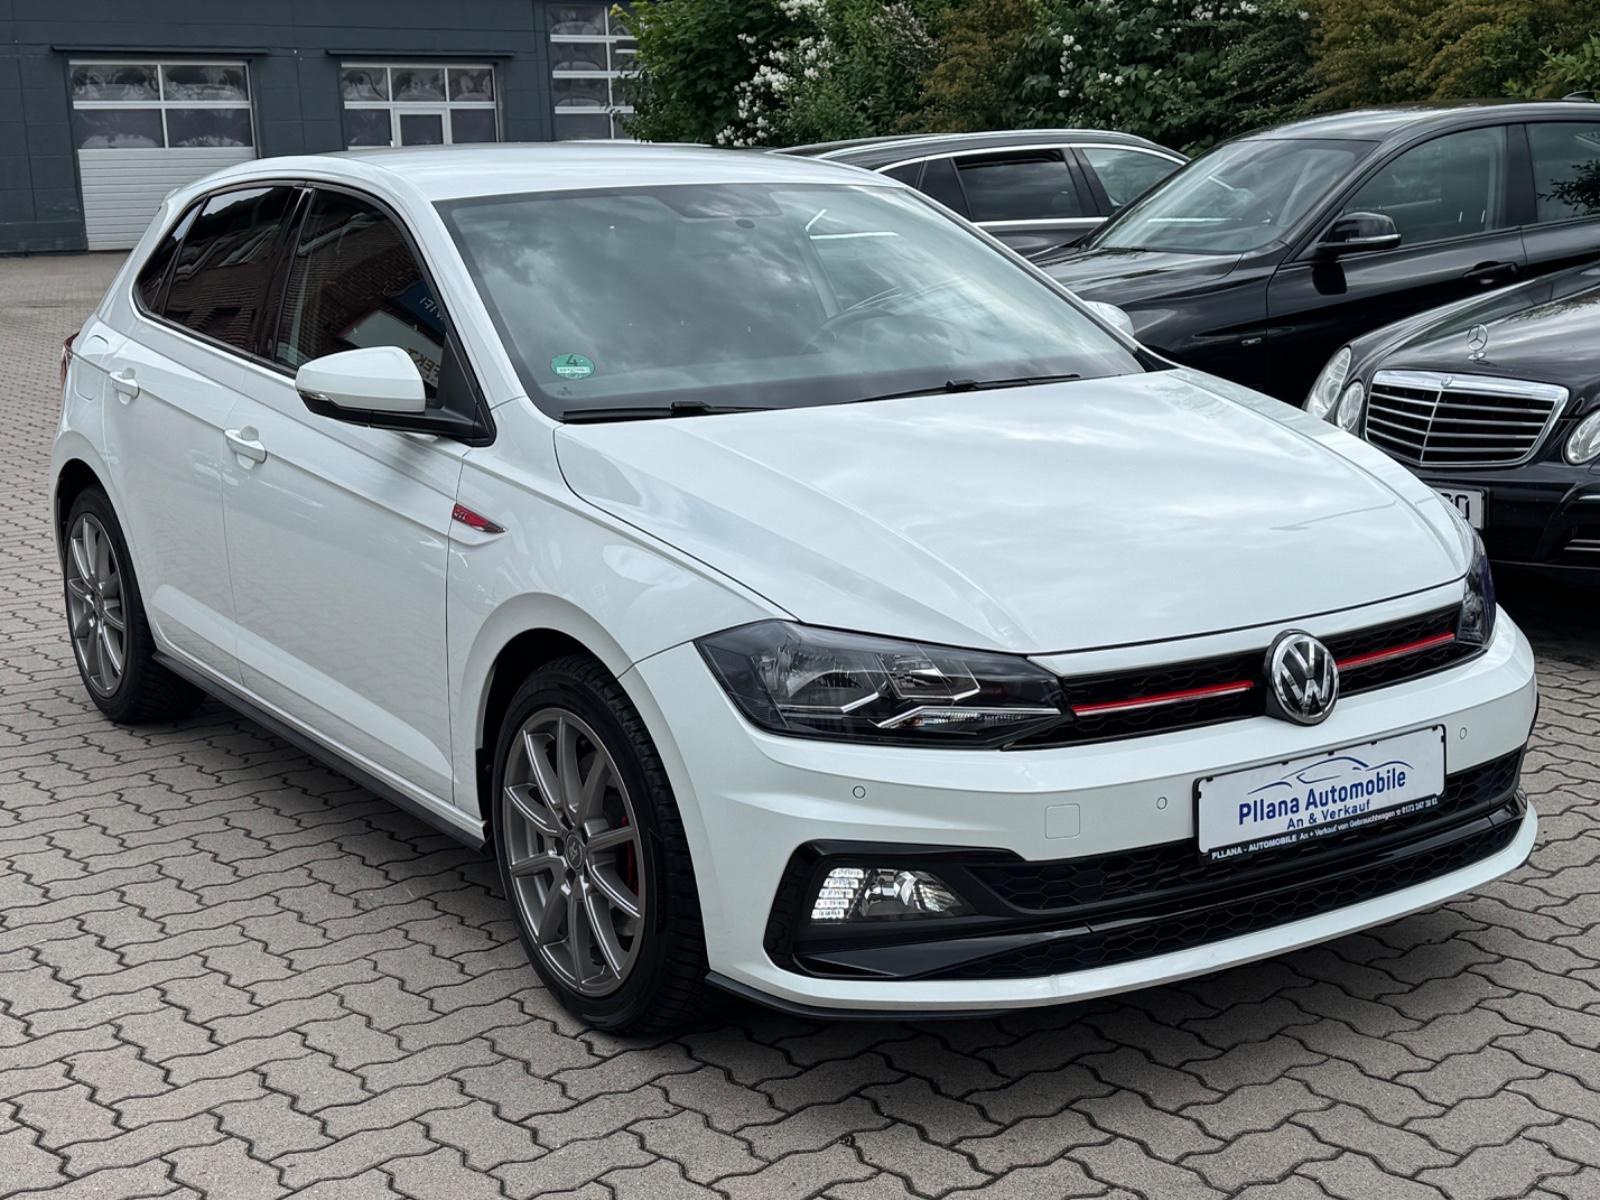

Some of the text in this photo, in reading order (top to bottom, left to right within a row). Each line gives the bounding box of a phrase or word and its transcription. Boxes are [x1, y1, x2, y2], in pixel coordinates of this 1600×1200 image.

[566, 354, 577, 366] 4
[1239, 768, 1406, 825] Pllana Automobile
[1287, 799, 1371, 830] An & Verkauf
[1211, 847, 1243, 860] PLLANA
[1248, 834, 1297, 852] AUTOMOBILE
